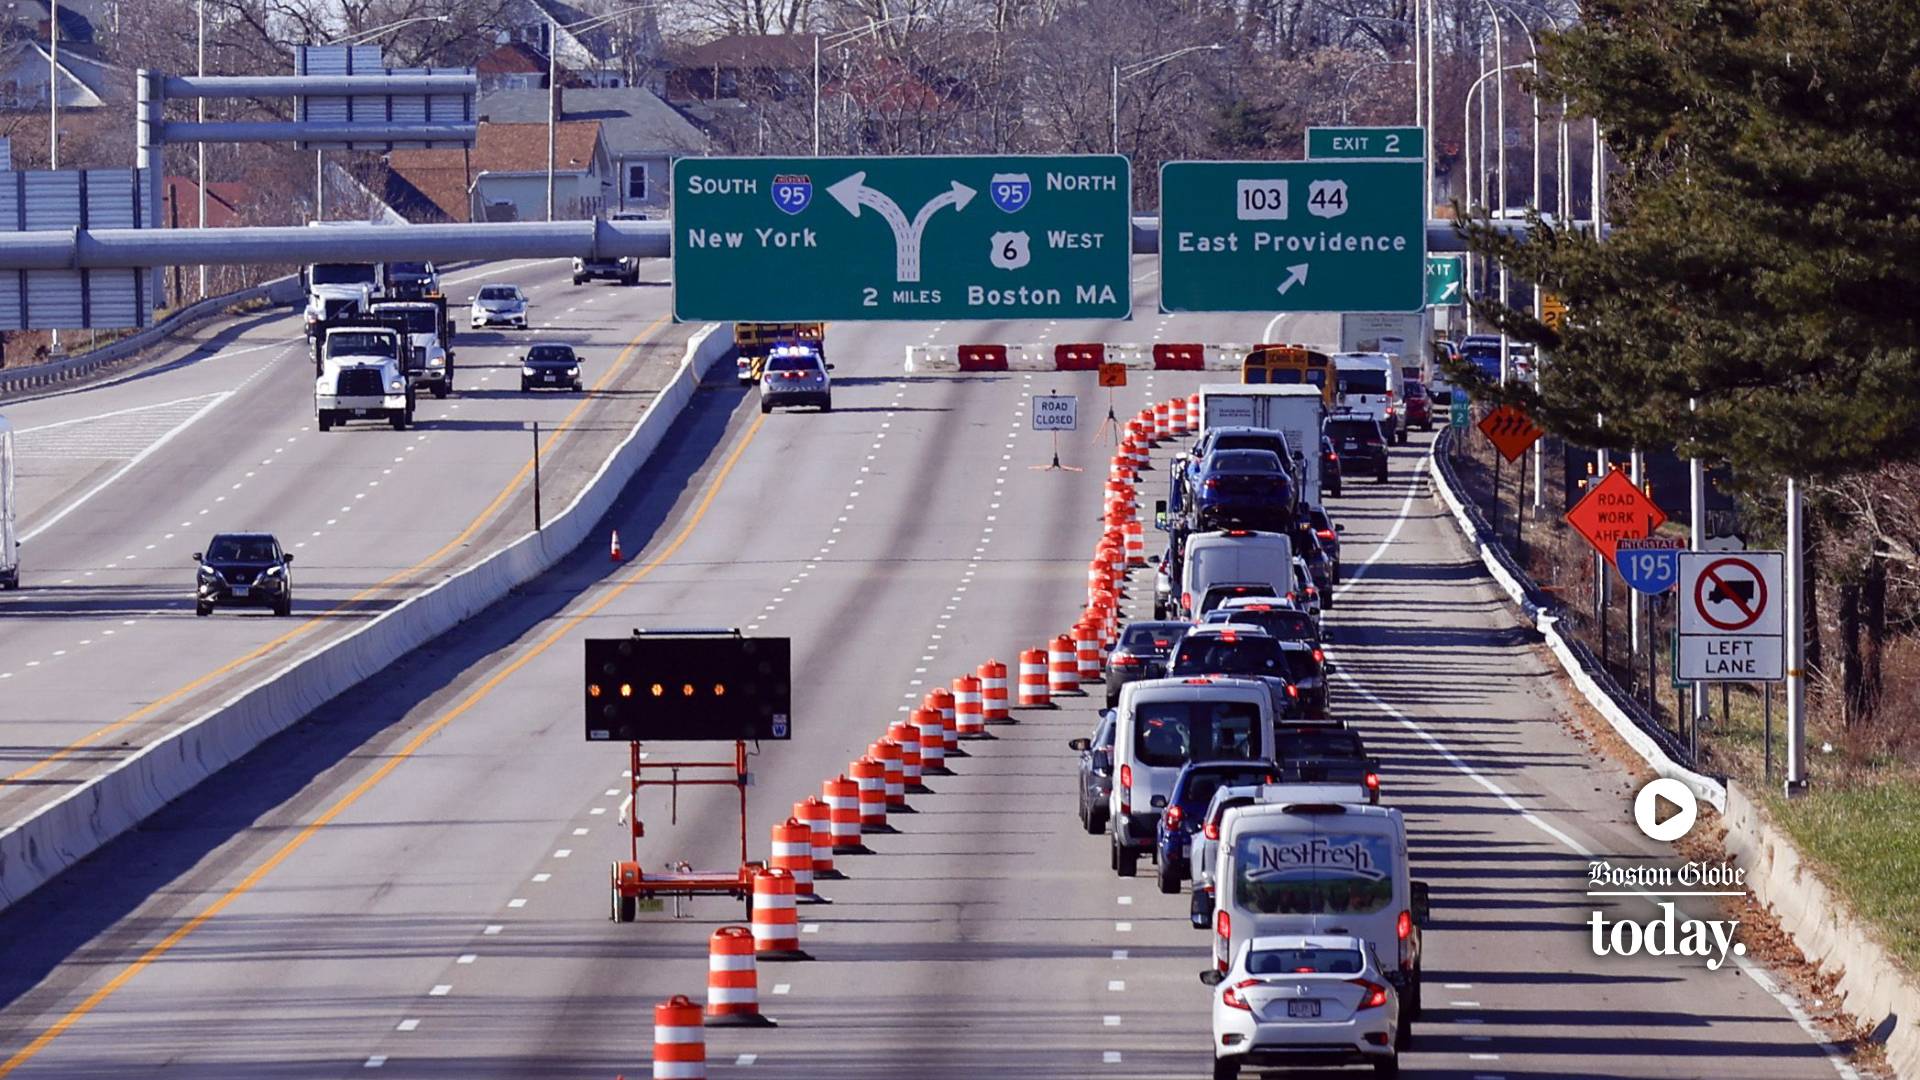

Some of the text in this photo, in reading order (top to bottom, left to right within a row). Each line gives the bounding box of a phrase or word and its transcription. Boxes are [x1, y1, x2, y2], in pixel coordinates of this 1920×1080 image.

[1332, 134, 1400, 152] EXIT 2
[687, 175, 757, 195] SOUTH
[1046, 173, 1117, 192] NORTH
[779, 186, 805, 205] 95
[997, 184, 1024, 204] 95
[1243, 188, 1281, 211] 103
[1309, 187, 1345, 210] 44
[689, 228, 817, 248] New York
[1047, 230, 1105, 250] WEST
[1178, 231, 1407, 252] East Providence
[1002, 238, 1017, 261] 6
[1426, 263, 1451, 276] XIT
[862, 288, 942, 306] 2 MILES
[967, 285, 1117, 306] Boston MA
[1041, 401, 1068, 411] ROAD
[1036, 415, 1073, 425] CLOSED
[1456, 413, 1464, 423] 2
[1597, 493, 1635, 506] ROAD
[1597, 512, 1635, 524] WORK
[1594, 530, 1640, 542] AHEAD
[1620, 541, 1680, 549] INTERSTATE
[1630, 554, 1671, 581] 195
[1707, 641, 1754, 656] LEFT
[1705, 659, 1756, 674] LANE
[1261, 839, 1370, 872] NestFresh
